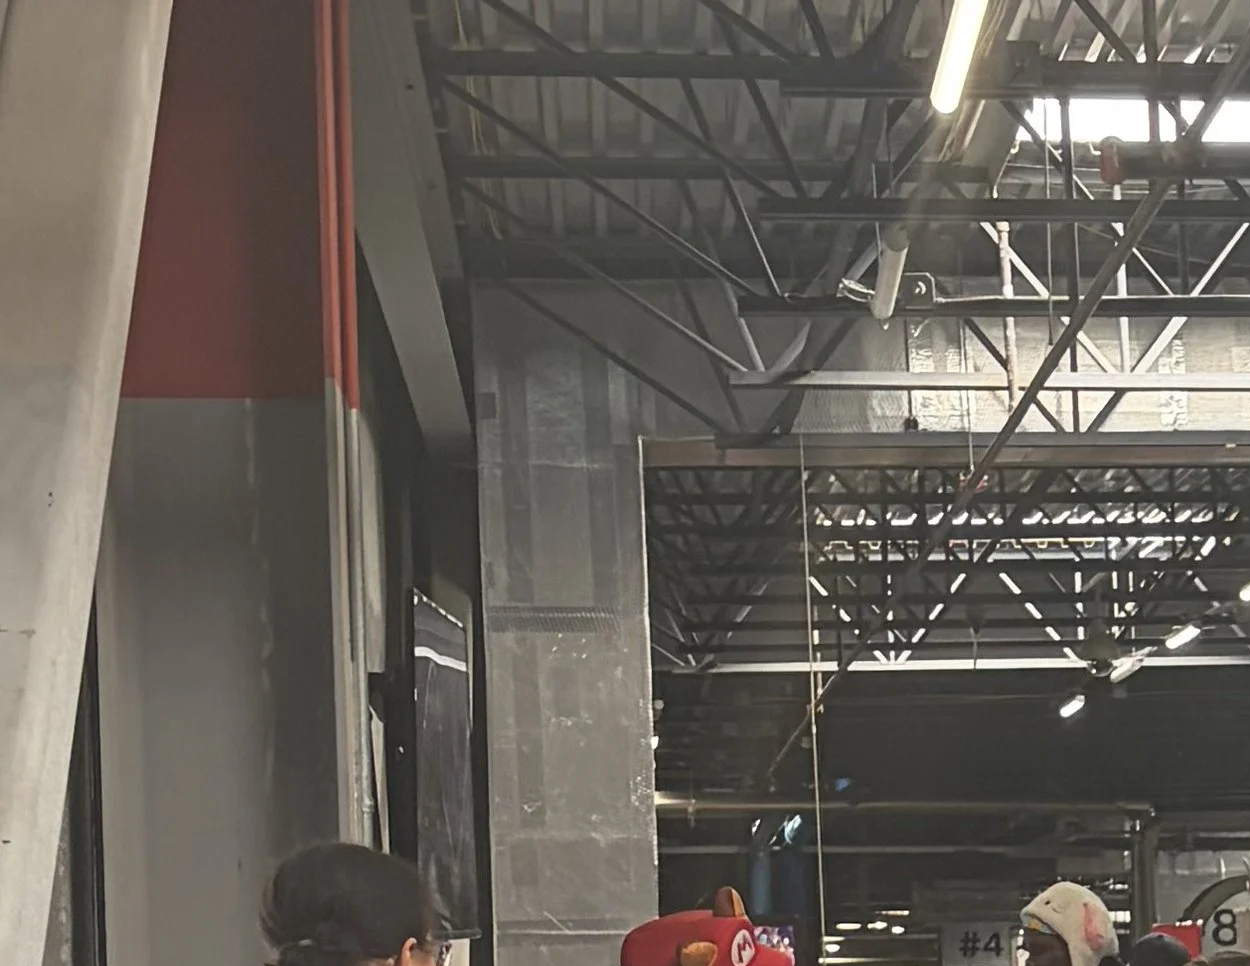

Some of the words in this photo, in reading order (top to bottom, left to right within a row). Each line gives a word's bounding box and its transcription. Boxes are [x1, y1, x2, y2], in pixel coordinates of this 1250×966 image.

[1212, 908, 1237, 947] 8
[736, 932, 753, 964] M
[958, 930, 1004, 958] #4
